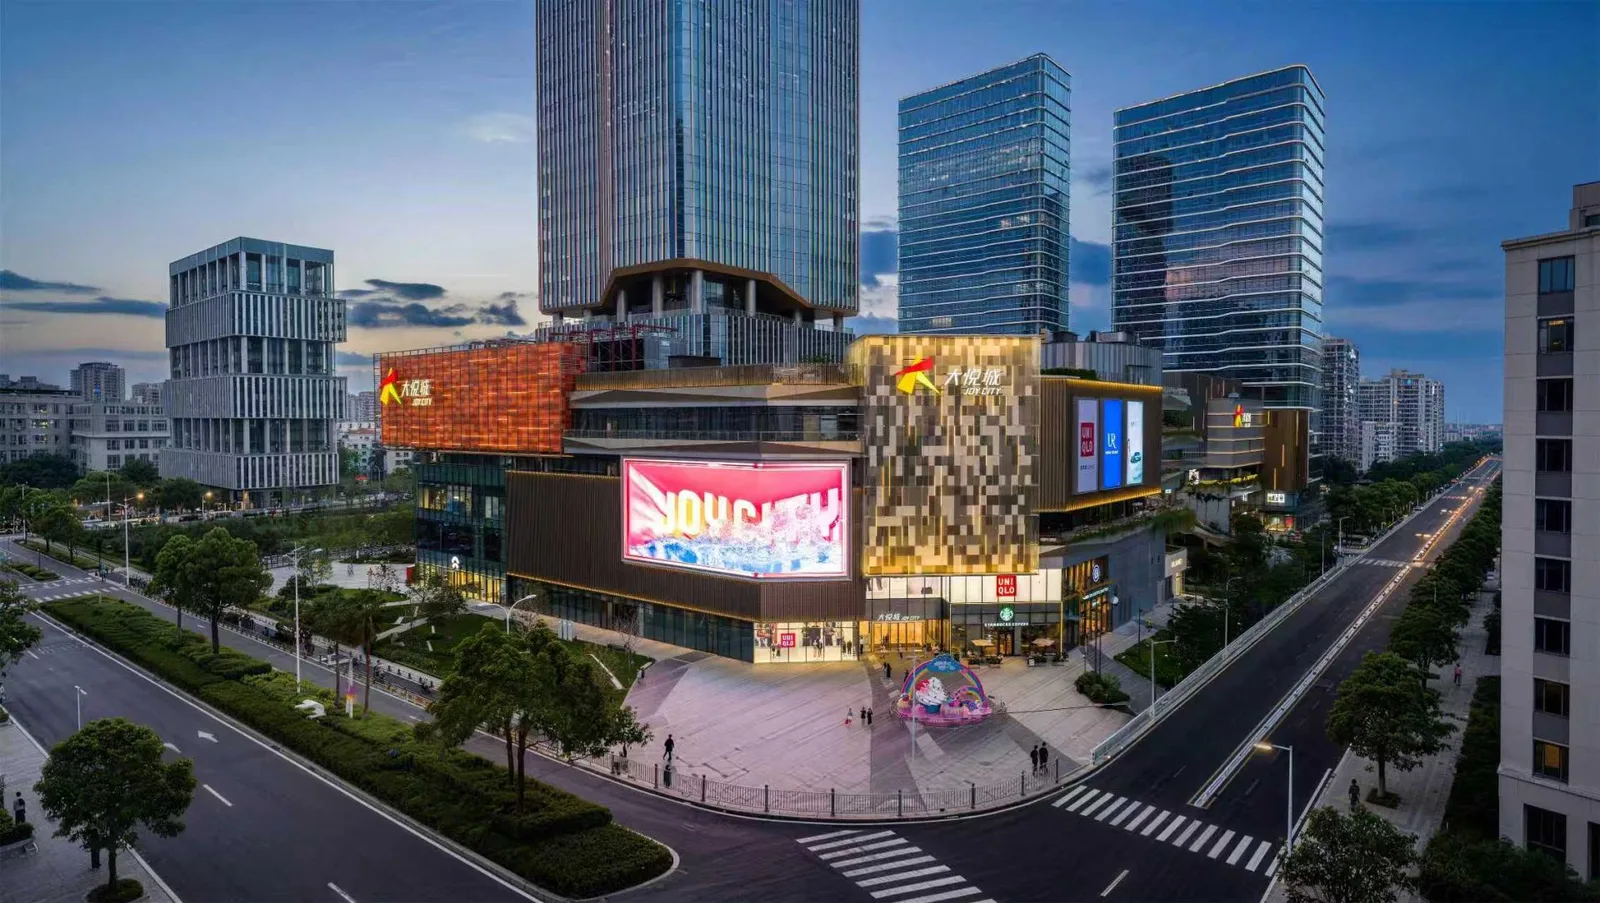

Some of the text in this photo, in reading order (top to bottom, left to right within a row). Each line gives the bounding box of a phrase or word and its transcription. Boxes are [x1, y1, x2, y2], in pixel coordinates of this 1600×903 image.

[944, 368, 1002, 386] 大悦城
[401, 379, 430, 397] 大悦城
[963, 387, 1002, 396] JOY CITY
[1107, 432, 1117, 449] UR
[998, 577, 1014, 586] UNI
[998, 586, 1015, 595] QLO
